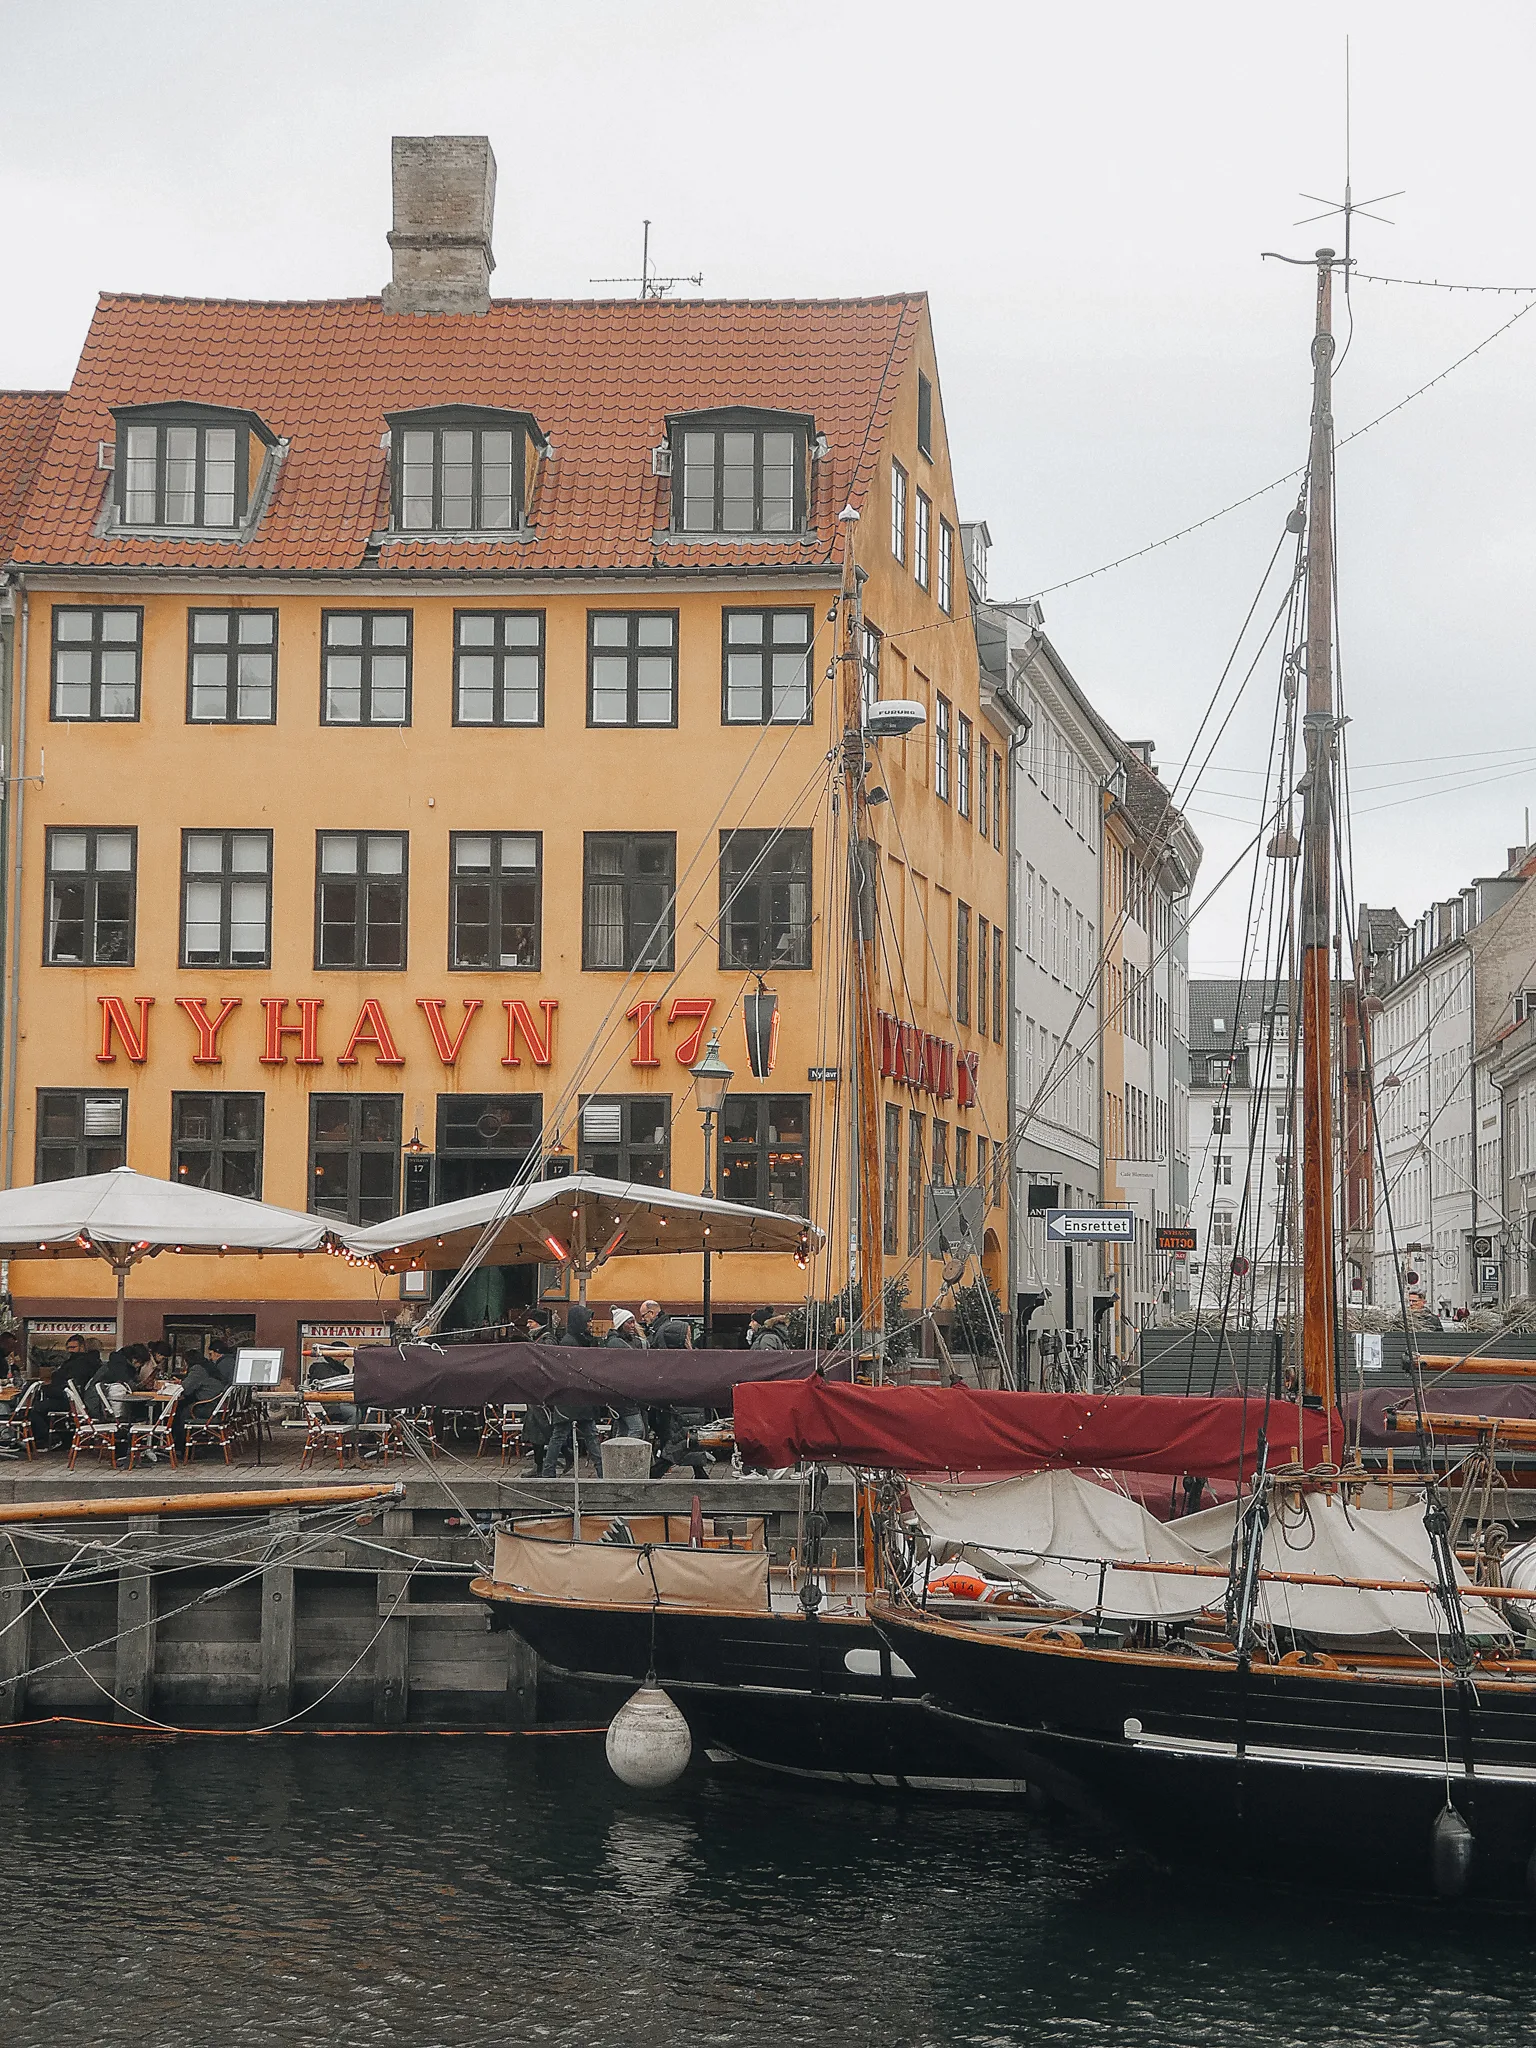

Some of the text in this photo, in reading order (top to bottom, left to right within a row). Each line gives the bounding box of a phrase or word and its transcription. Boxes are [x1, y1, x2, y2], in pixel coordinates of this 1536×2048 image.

[95, 995, 716, 1067] NYHAVN 17
[413, 1164, 424, 1172] 17
[553, 1165, 563, 1174] 17
[1064, 1220, 1127, 1232] Ensrettet
[1159, 1237, 1194, 1249] TATTOO
[1485, 1266, 1496, 1280] P
[311, 1326, 383, 1336] NYHAVN 17
